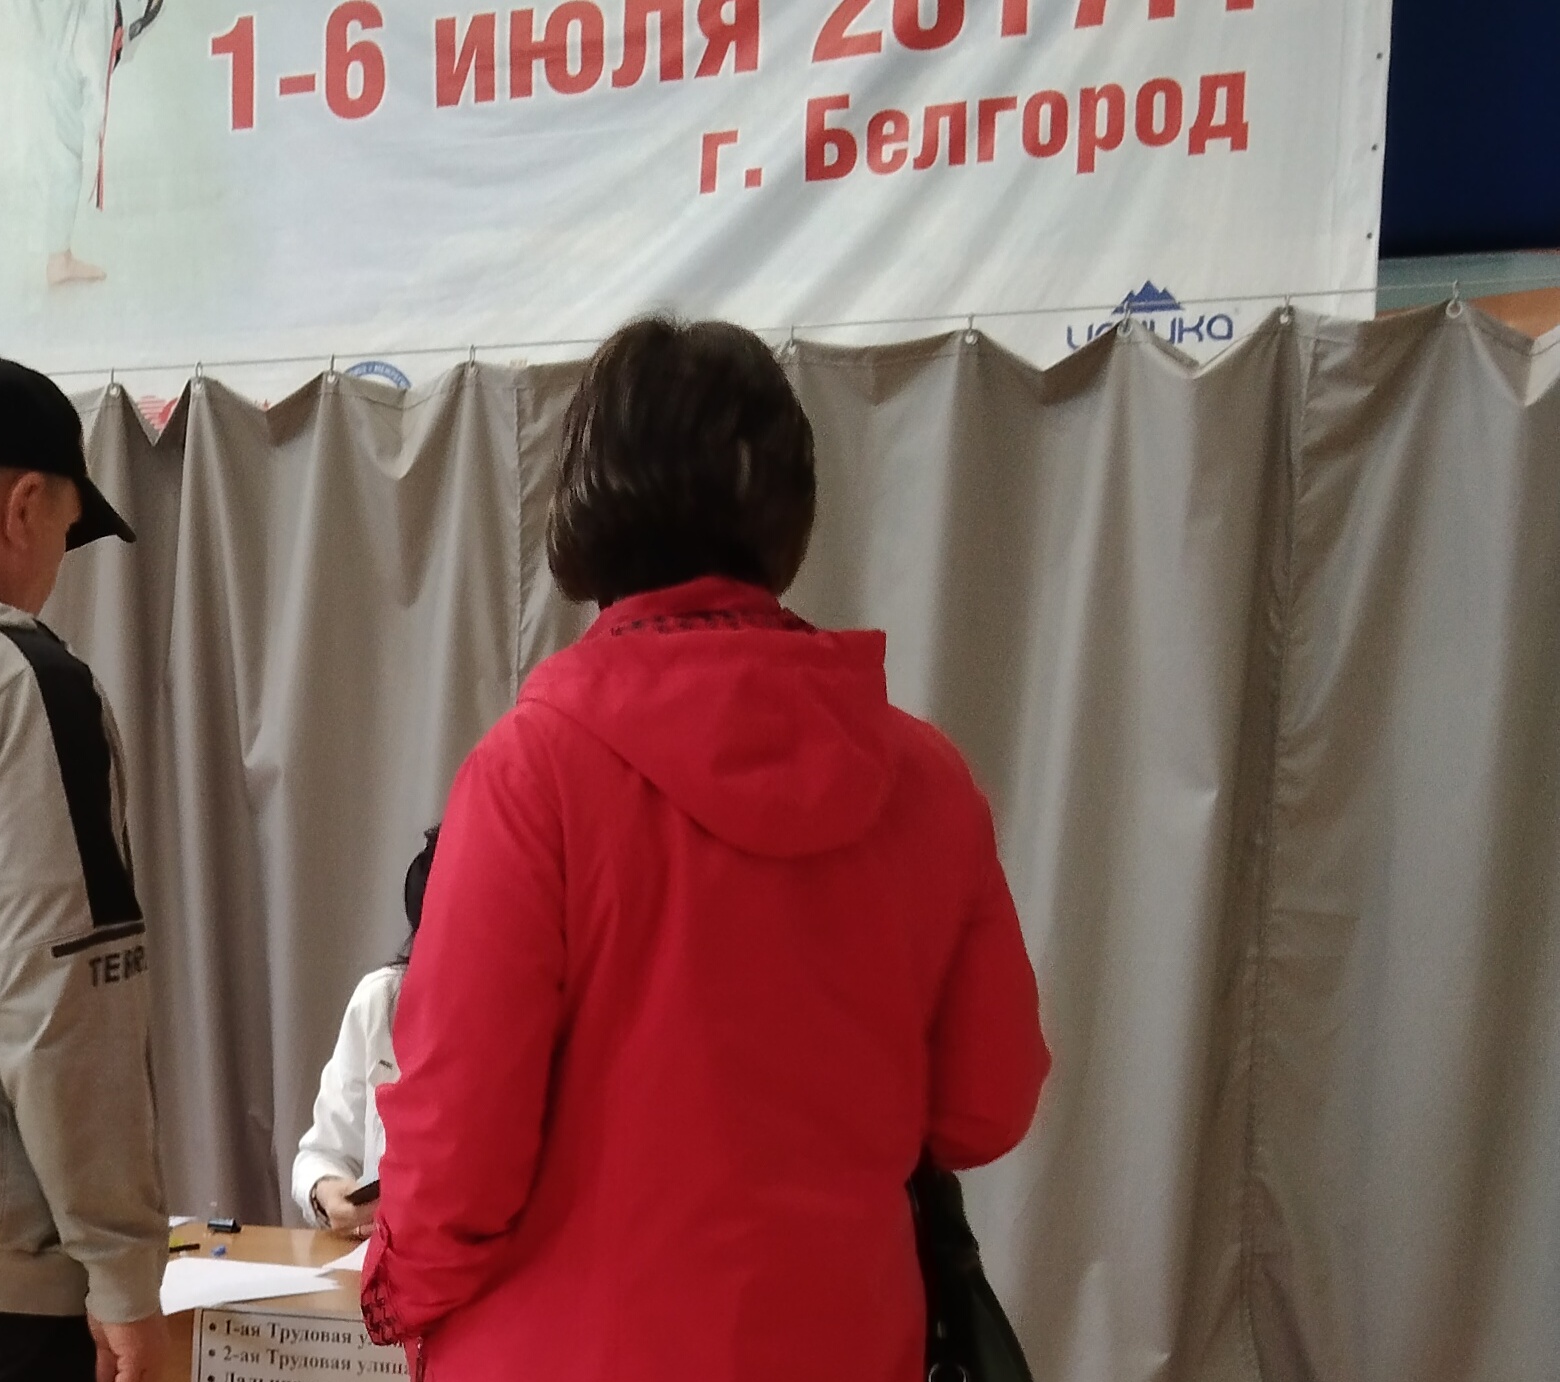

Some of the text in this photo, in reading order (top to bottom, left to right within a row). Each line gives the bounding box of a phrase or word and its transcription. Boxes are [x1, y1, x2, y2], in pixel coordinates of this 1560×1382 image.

[211, 0, 385, 131] 1-6
[435, 0, 759, 108] июля
[700, 71, 1249, 194] г. Белгород
[223, 1345, 260, 1364] 2-ая
[266, 1348, 351, 1371] Трудовая
[225, 1319, 260, 1337] 1-ая
[267, 1321, 352, 1345] Трудовая
